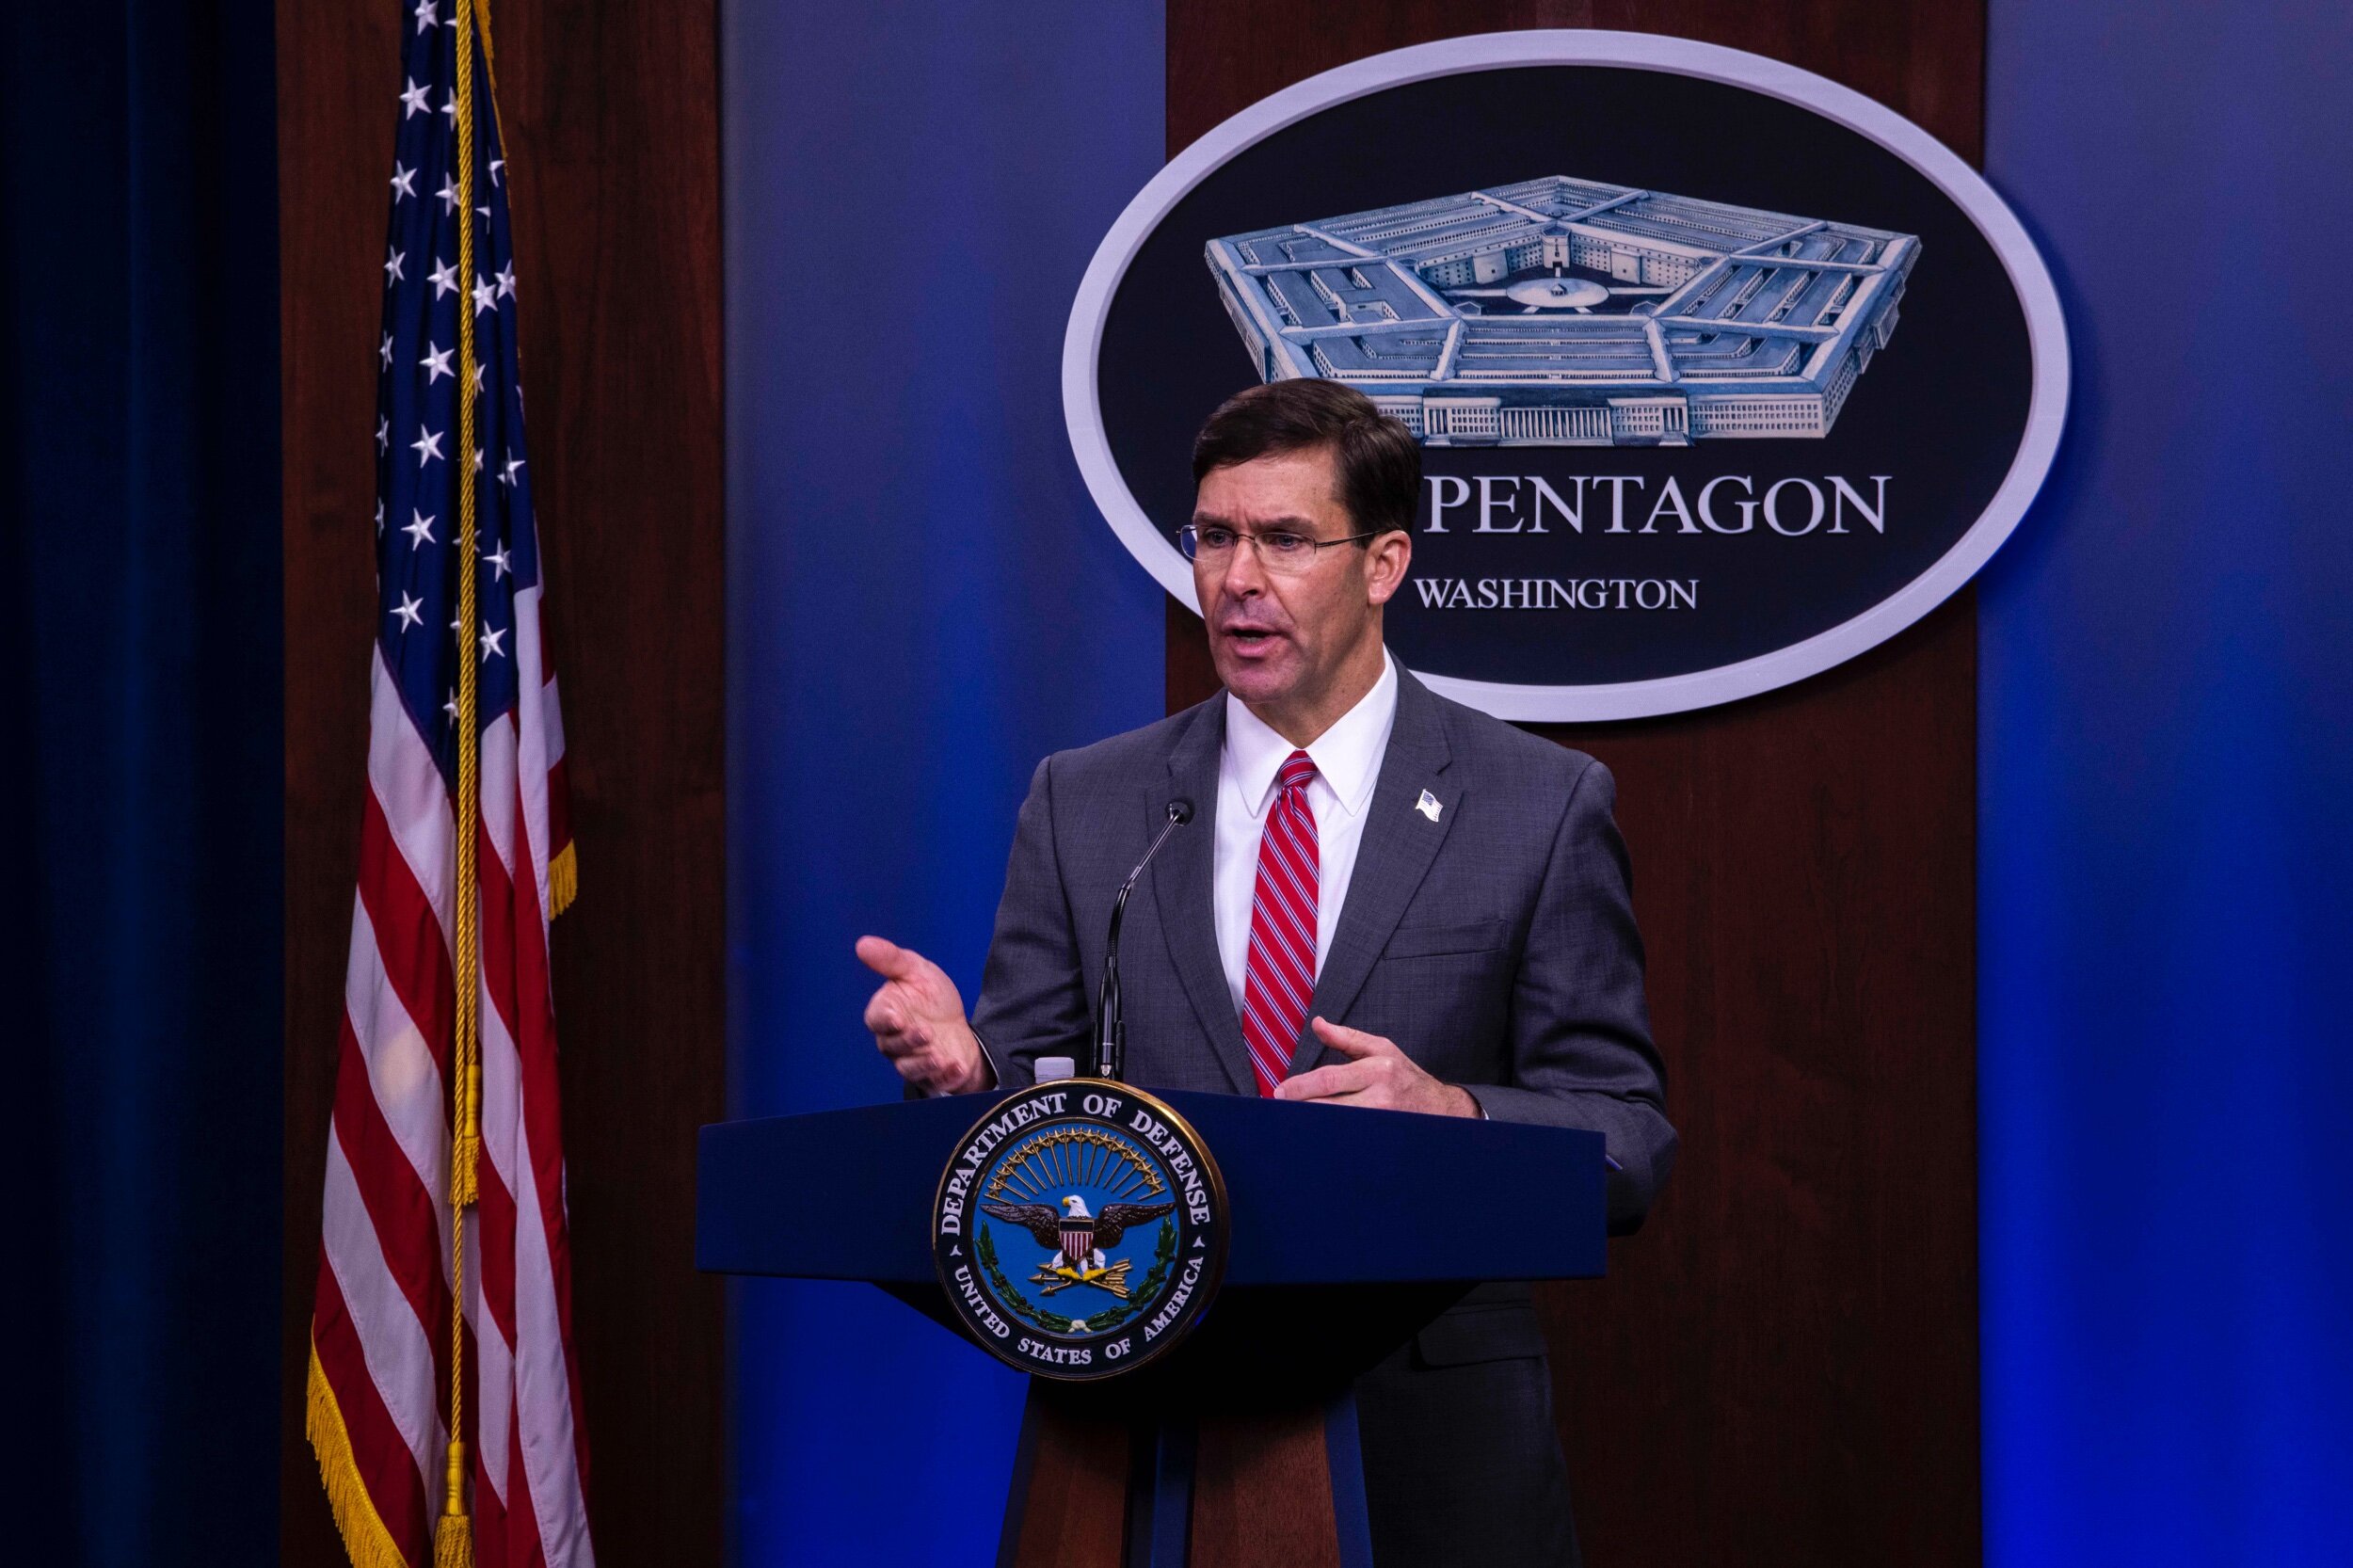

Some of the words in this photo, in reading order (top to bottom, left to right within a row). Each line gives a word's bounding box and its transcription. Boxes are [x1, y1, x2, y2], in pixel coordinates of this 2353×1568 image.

[1423, 475, 1893, 536] PENTAGON
[1414, 579, 1699, 610] WASHINGTON
[942, 1093, 1067, 1236] DEPARTMENT
[1082, 1093, 1123, 1119] OF
[1129, 1110, 1210, 1225] DEFENSE
[954, 1265, 1011, 1339] UNITED
[1017, 1337, 1092, 1365] STATES
[1105, 1338, 1131, 1360] OF
[1144, 1256, 1204, 1341] AMERICA
